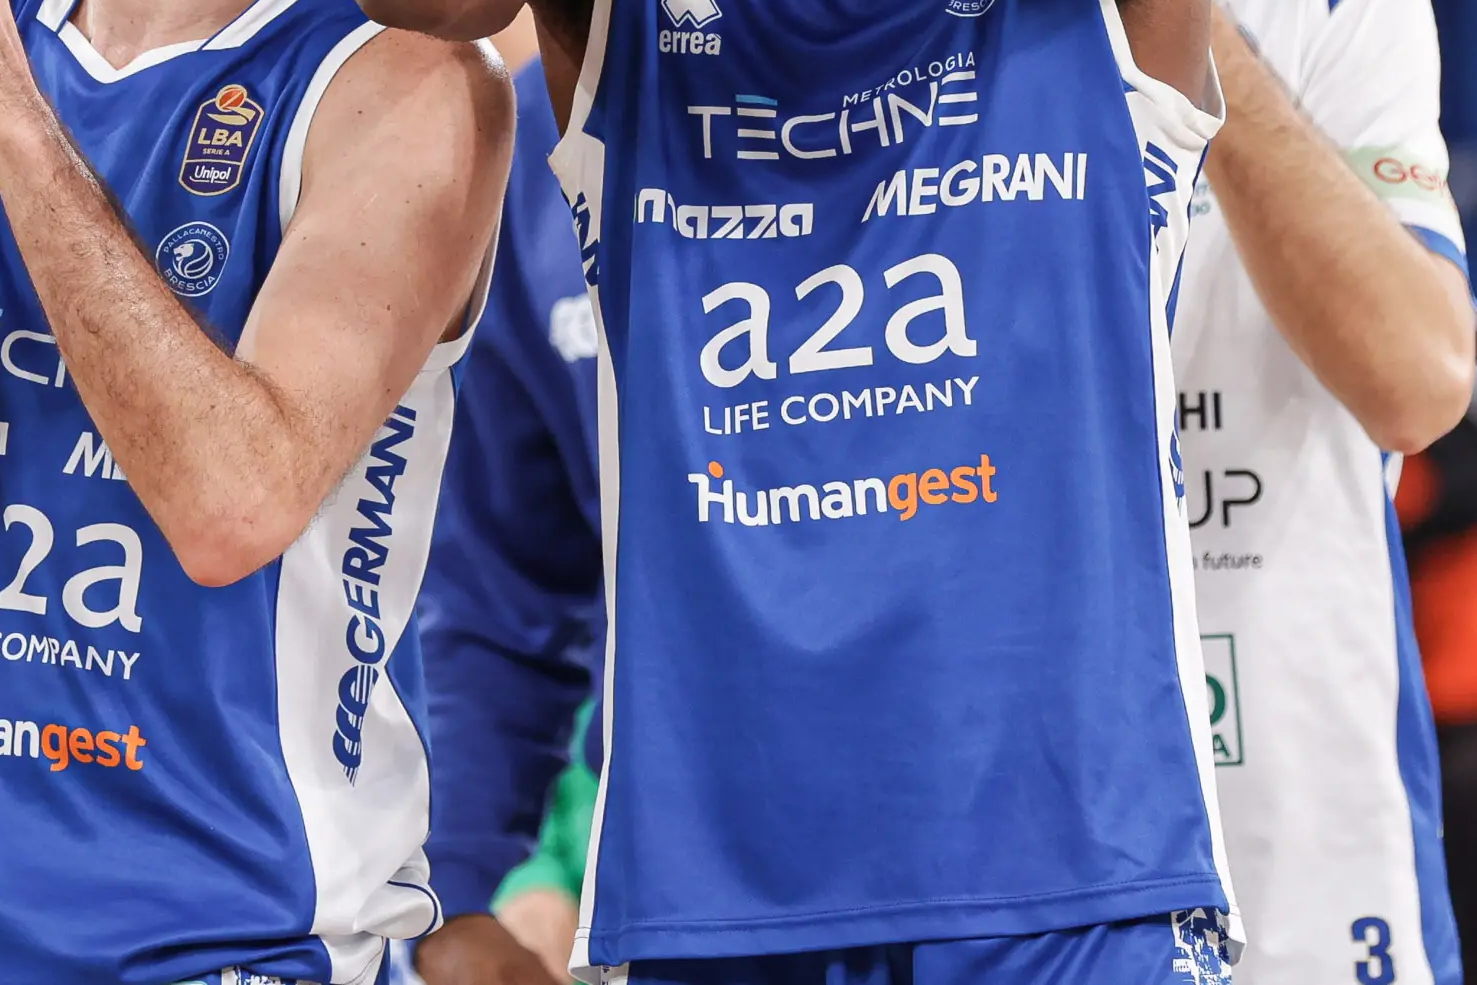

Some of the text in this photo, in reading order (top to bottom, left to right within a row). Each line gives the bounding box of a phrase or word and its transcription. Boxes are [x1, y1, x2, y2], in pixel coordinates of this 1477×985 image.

[843, 52, 976, 108] METROLOGIA
[197, 127, 243, 148] LBA
[687, 71, 979, 160] TECHNE
[194, 165, 232, 184] Unipol
[202, 147, 223, 155] SERIE
[861, 152, 1088, 223] MEGRANI
[163, 267, 216, 291] BRESCIA
[700, 253, 977, 387] a2a
[703, 376, 979, 435] LIFE COMPANY
[688, 454, 998, 528] Humangest
[1203, 551, 1264, 570] future
[1351, 915, 1395, 985] 3
